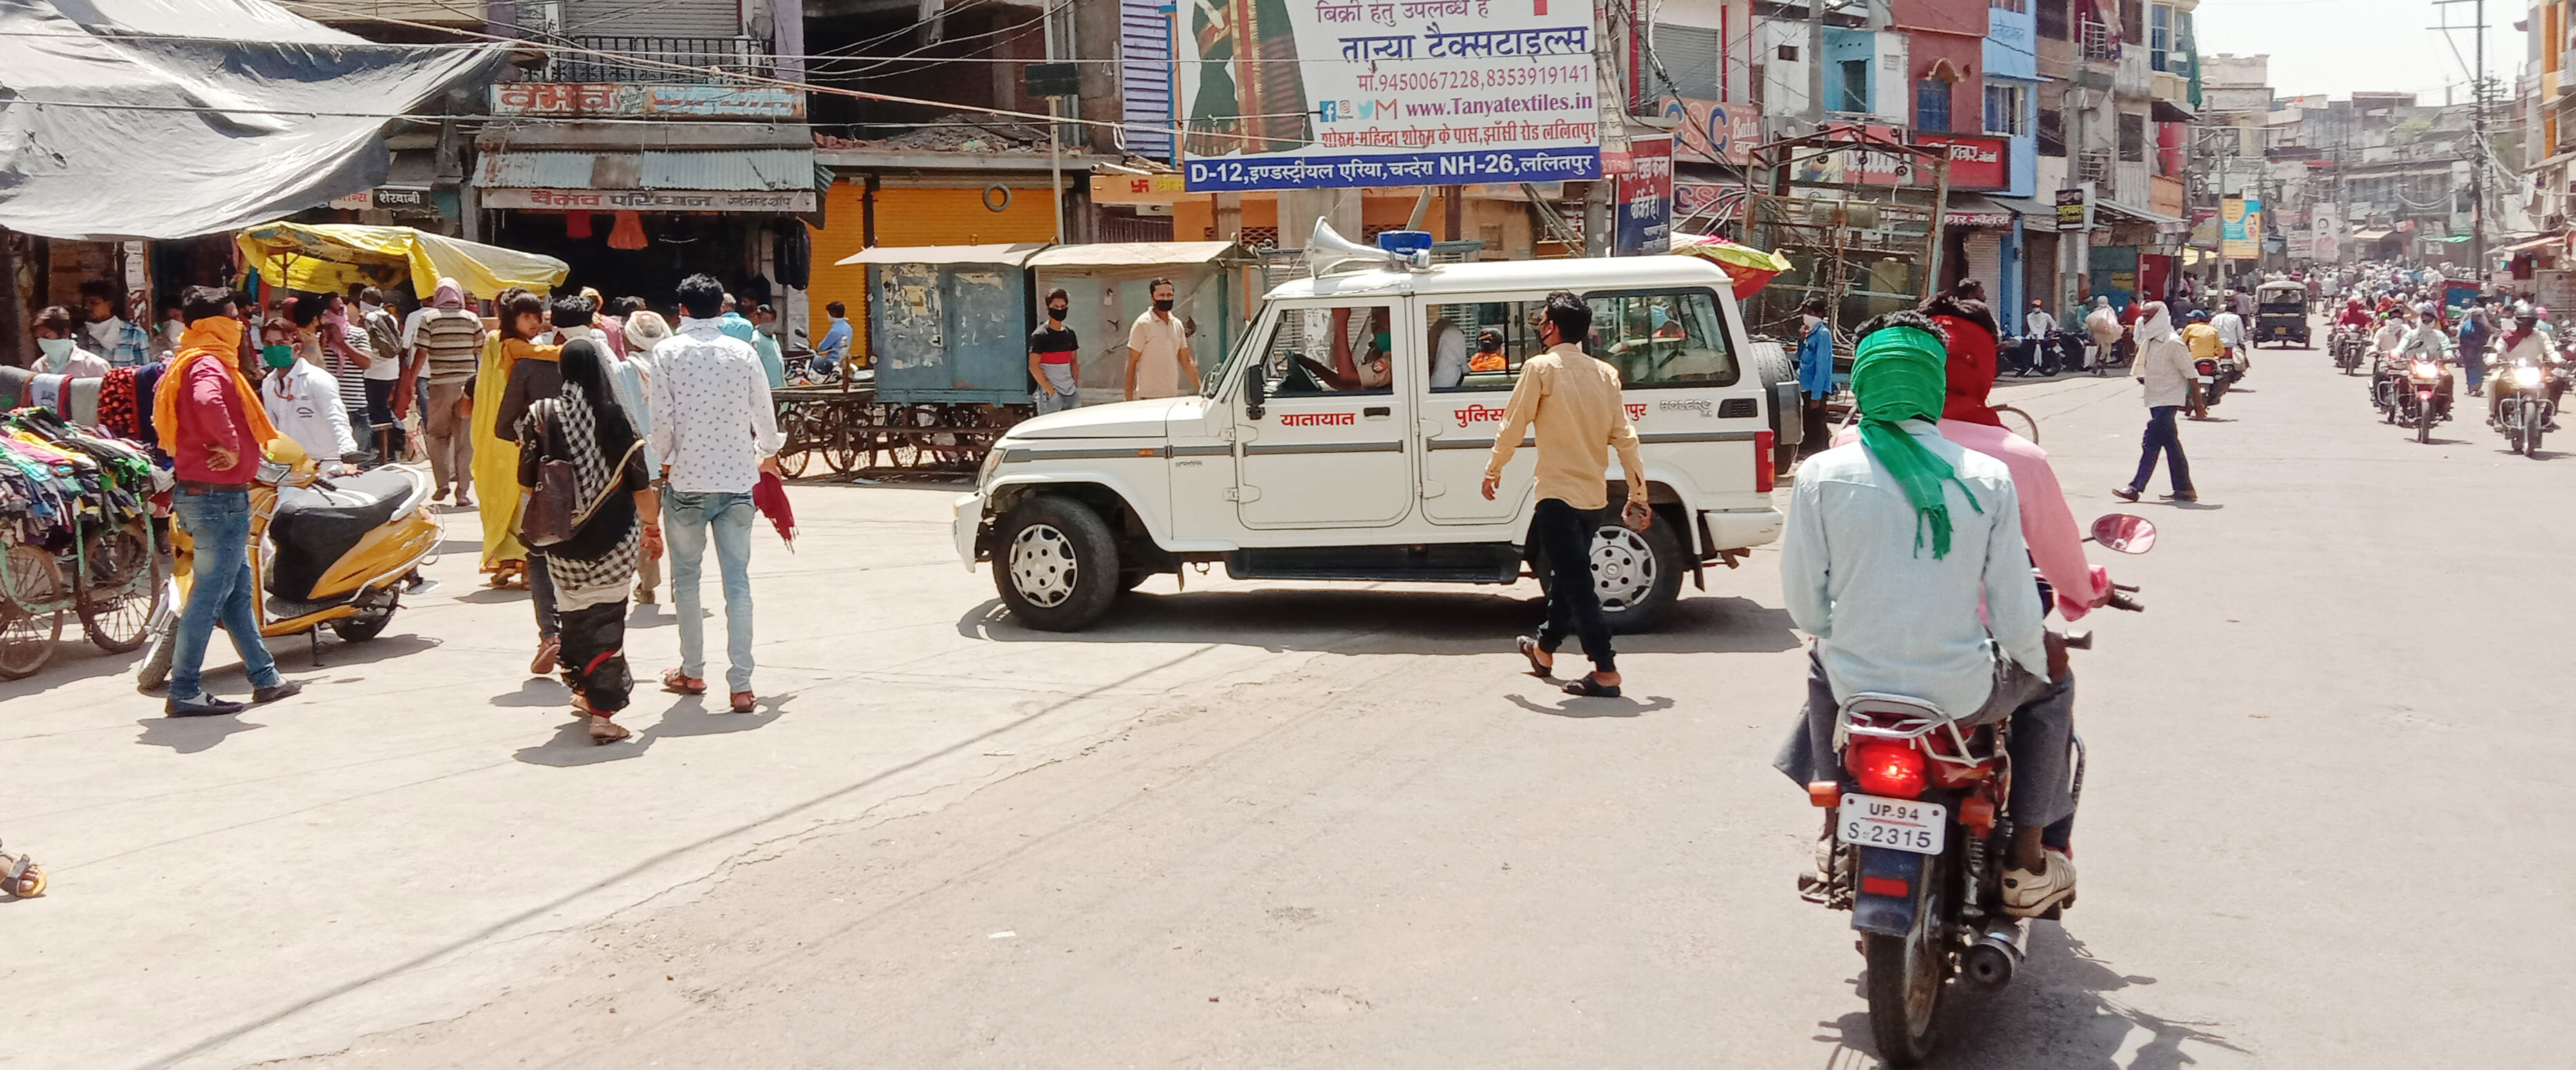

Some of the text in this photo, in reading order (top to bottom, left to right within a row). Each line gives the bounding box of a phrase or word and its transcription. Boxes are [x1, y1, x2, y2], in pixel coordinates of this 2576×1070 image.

[1400, 0, 1471, 19] उपलब्ध
[1338, 21, 1589, 64] तान्या टैक्सटाइल्स
[1406, 92, 1593, 118] www.Tanyatextiles.in
[1437, 123, 1452, 144] के
[1520, 119, 1540, 141] रोड
[1541, 118, 1597, 144] ललितपुर
[380, 190, 420, 204] शेरवानी
[1280, 404, 1506, 428] यातायात पुलिस
